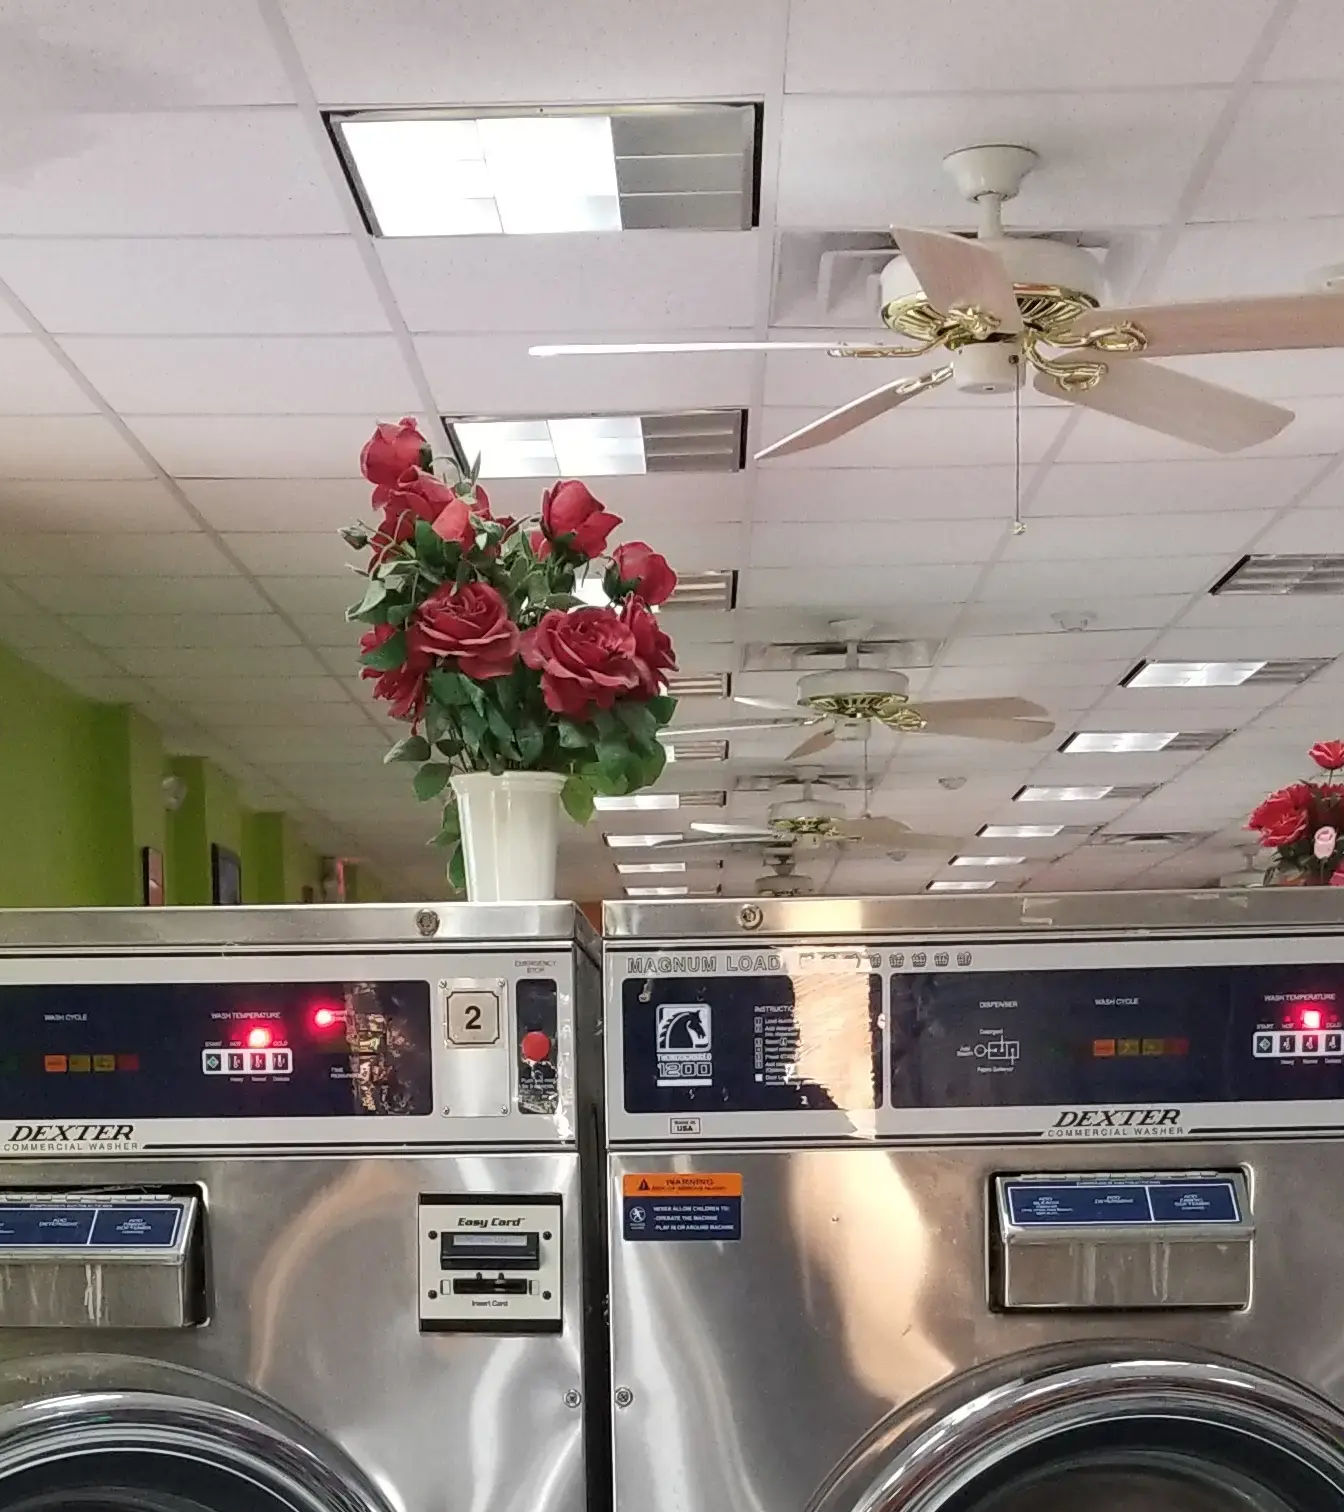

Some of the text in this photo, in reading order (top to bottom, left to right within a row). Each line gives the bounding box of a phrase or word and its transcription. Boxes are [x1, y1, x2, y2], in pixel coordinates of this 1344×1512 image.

[628, 955, 780, 973] MAGNUM LOAD
[464, 1005, 482, 1030] 2
[658, 1062, 712, 1077] 1200
[1053, 1109, 1181, 1127] DEXTER
[8, 1124, 134, 1141] DEXTER
[1048, 1129, 1128, 1137] COMMERCIAL
[458, 1218, 522, 1228] Easy Card
